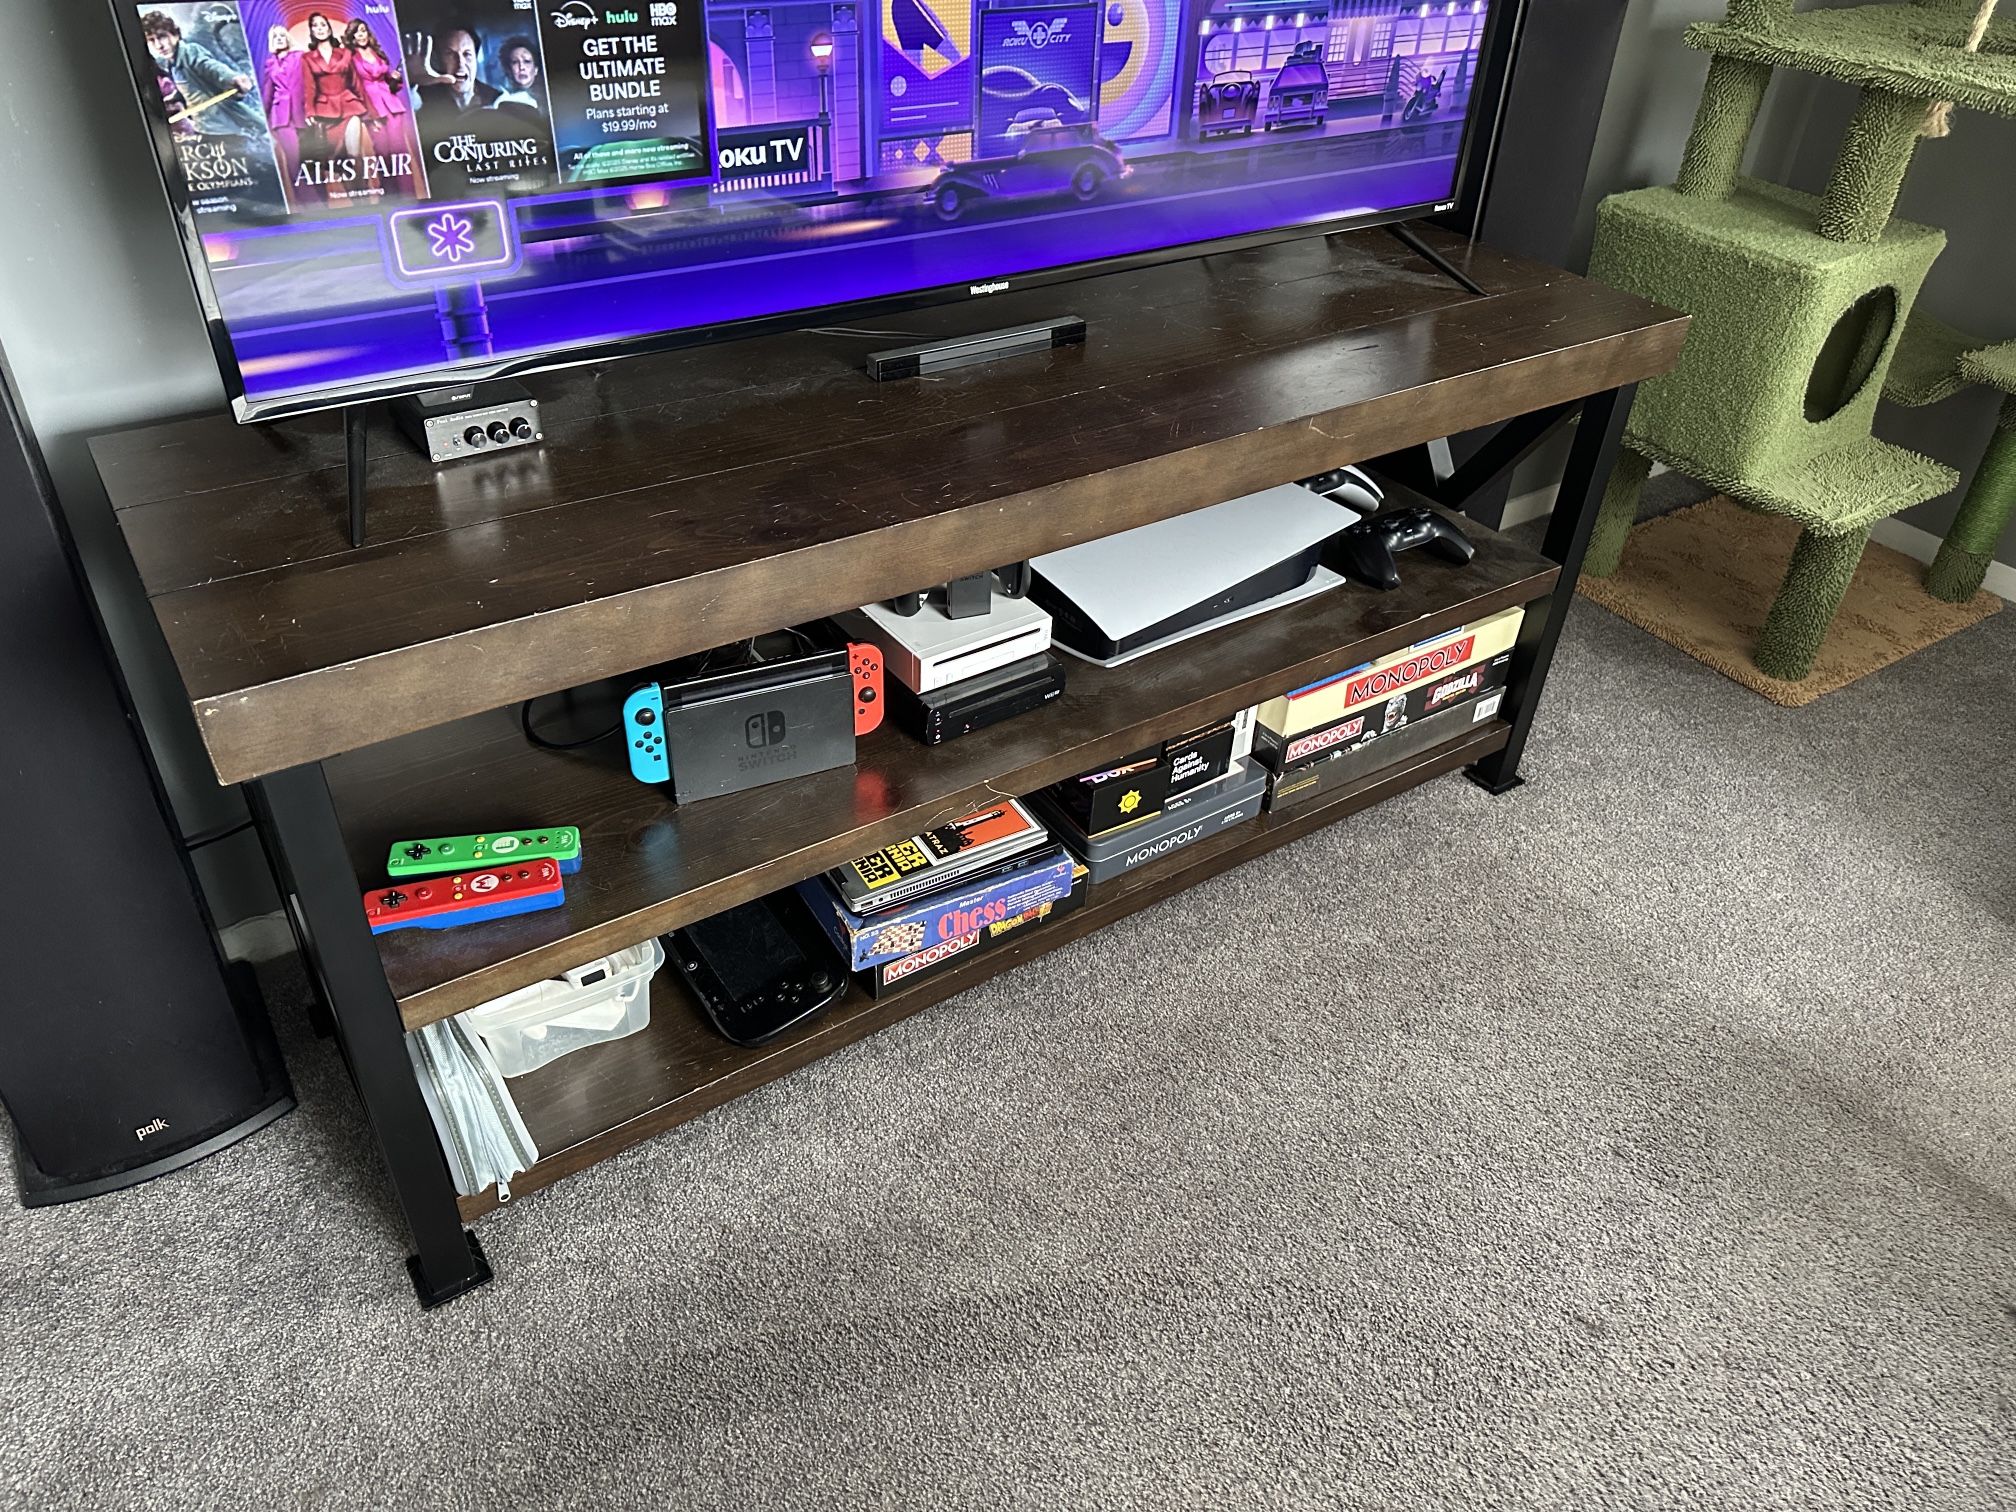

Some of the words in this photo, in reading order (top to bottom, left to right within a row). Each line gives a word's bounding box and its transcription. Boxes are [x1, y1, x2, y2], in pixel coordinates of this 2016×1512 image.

[365, 4, 389, 14] hulu
[550, 5, 599, 29] Disney+
[606, 10, 638, 24] hulu
[650, 2, 677, 15] HBO
[651, 16, 677, 26] max
[582, 37, 619, 57] GET
[621, 35, 658, 54] THE
[1049, 34, 1072, 43] CITY
[579, 57, 666, 80] ULTIMATE
[589, 80, 661, 101] BUNDLE
[586, 108, 614, 120] Plans
[616, 103, 656, 117] starting
[658, 103, 669, 114] at
[602, 119, 657, 133] $19.99/mo
[180, 141, 226, 161] RCY
[433, 138, 537, 163] CONJURING
[449, 134, 476, 147] THE
[769, 137, 804, 163] TV
[183, 157, 249, 180] KSON
[294, 158, 356, 187] ALL'S
[362, 153, 412, 180] FAIR
[466, 161, 498, 173] LAST
[509, 155, 547, 168] RITES
[486, 173, 519, 183] streaming
[970, 281, 1009, 295] Westinghouse
[1349, 639, 1468, 705] MONOPOLY
[1431, 672, 1478, 705] GODZILLA
[1288, 720, 1361, 759] MONOPOLY
[738, 750, 797, 771] SWITCH
[1171, 756, 1203, 775] Against
[1173, 751, 1198, 767] Cards
[1170, 762, 1210, 783] Humanity
[925, 832, 949, 855] ATRAZ
[1125, 826, 1201, 866] MONOPOLY
[959, 896, 984, 908] Master
[938, 898, 1007, 940] Chess
[989, 914, 1025, 938] DRAGON
[887, 932, 978, 981] MONOPOLY
[135, 1117, 170, 1141] polk
